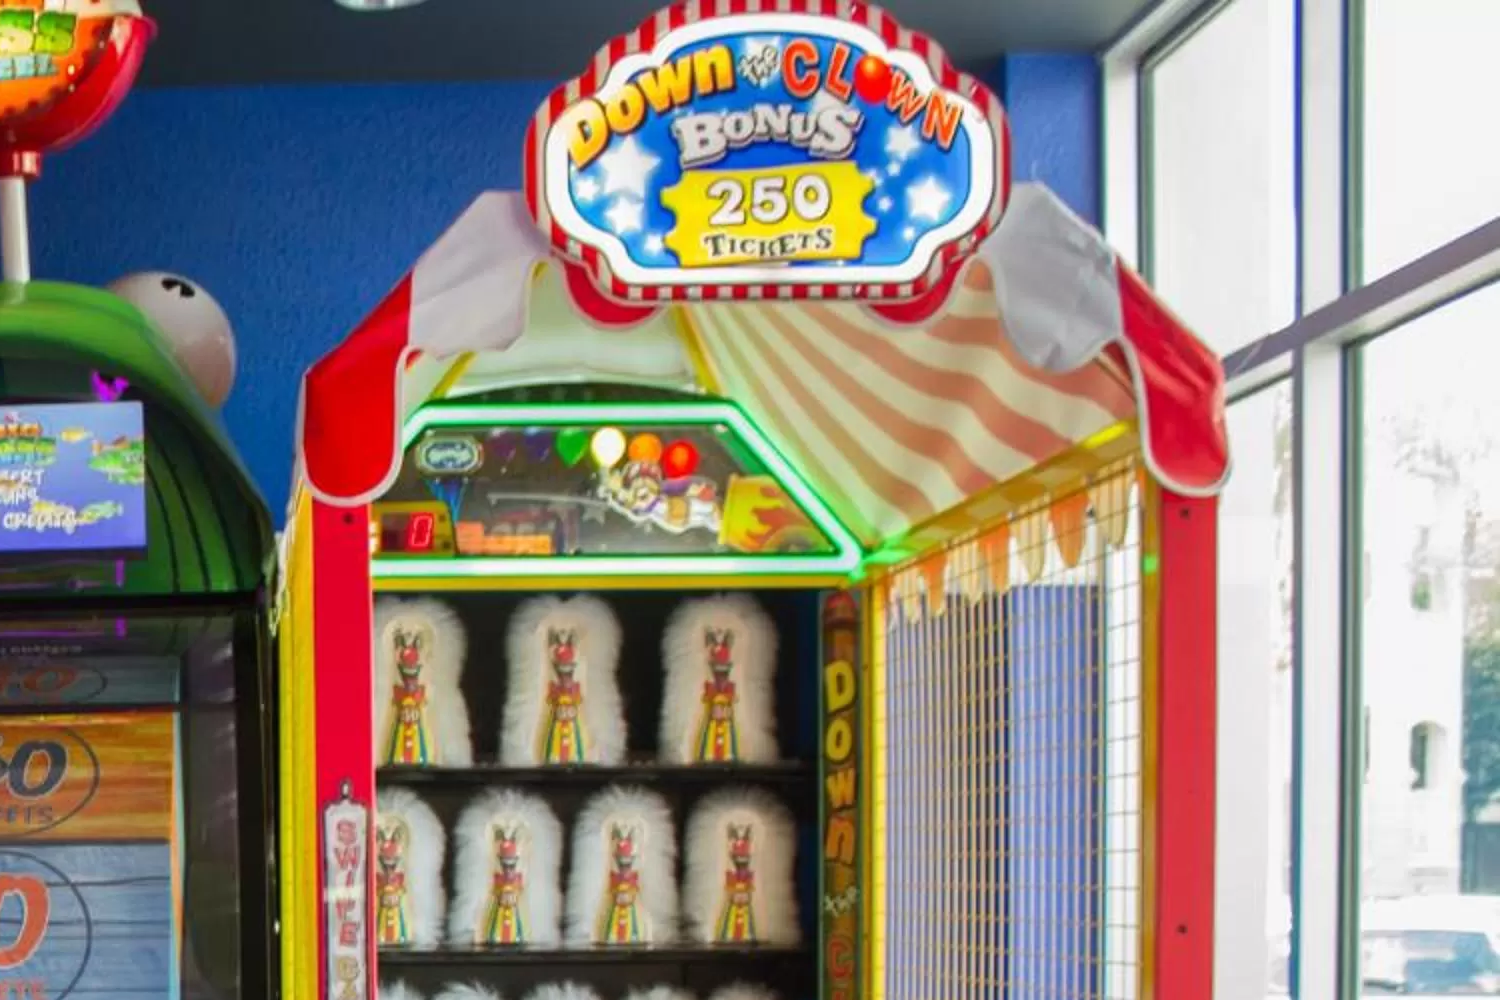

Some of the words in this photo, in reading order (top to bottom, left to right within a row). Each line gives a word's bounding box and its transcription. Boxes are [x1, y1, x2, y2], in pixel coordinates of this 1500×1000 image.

[673, 97, 865, 169] BONUS
[707, 174, 831, 227] 250
[703, 227, 835, 259] TICKETS
[410, 514, 434, 548] 0
